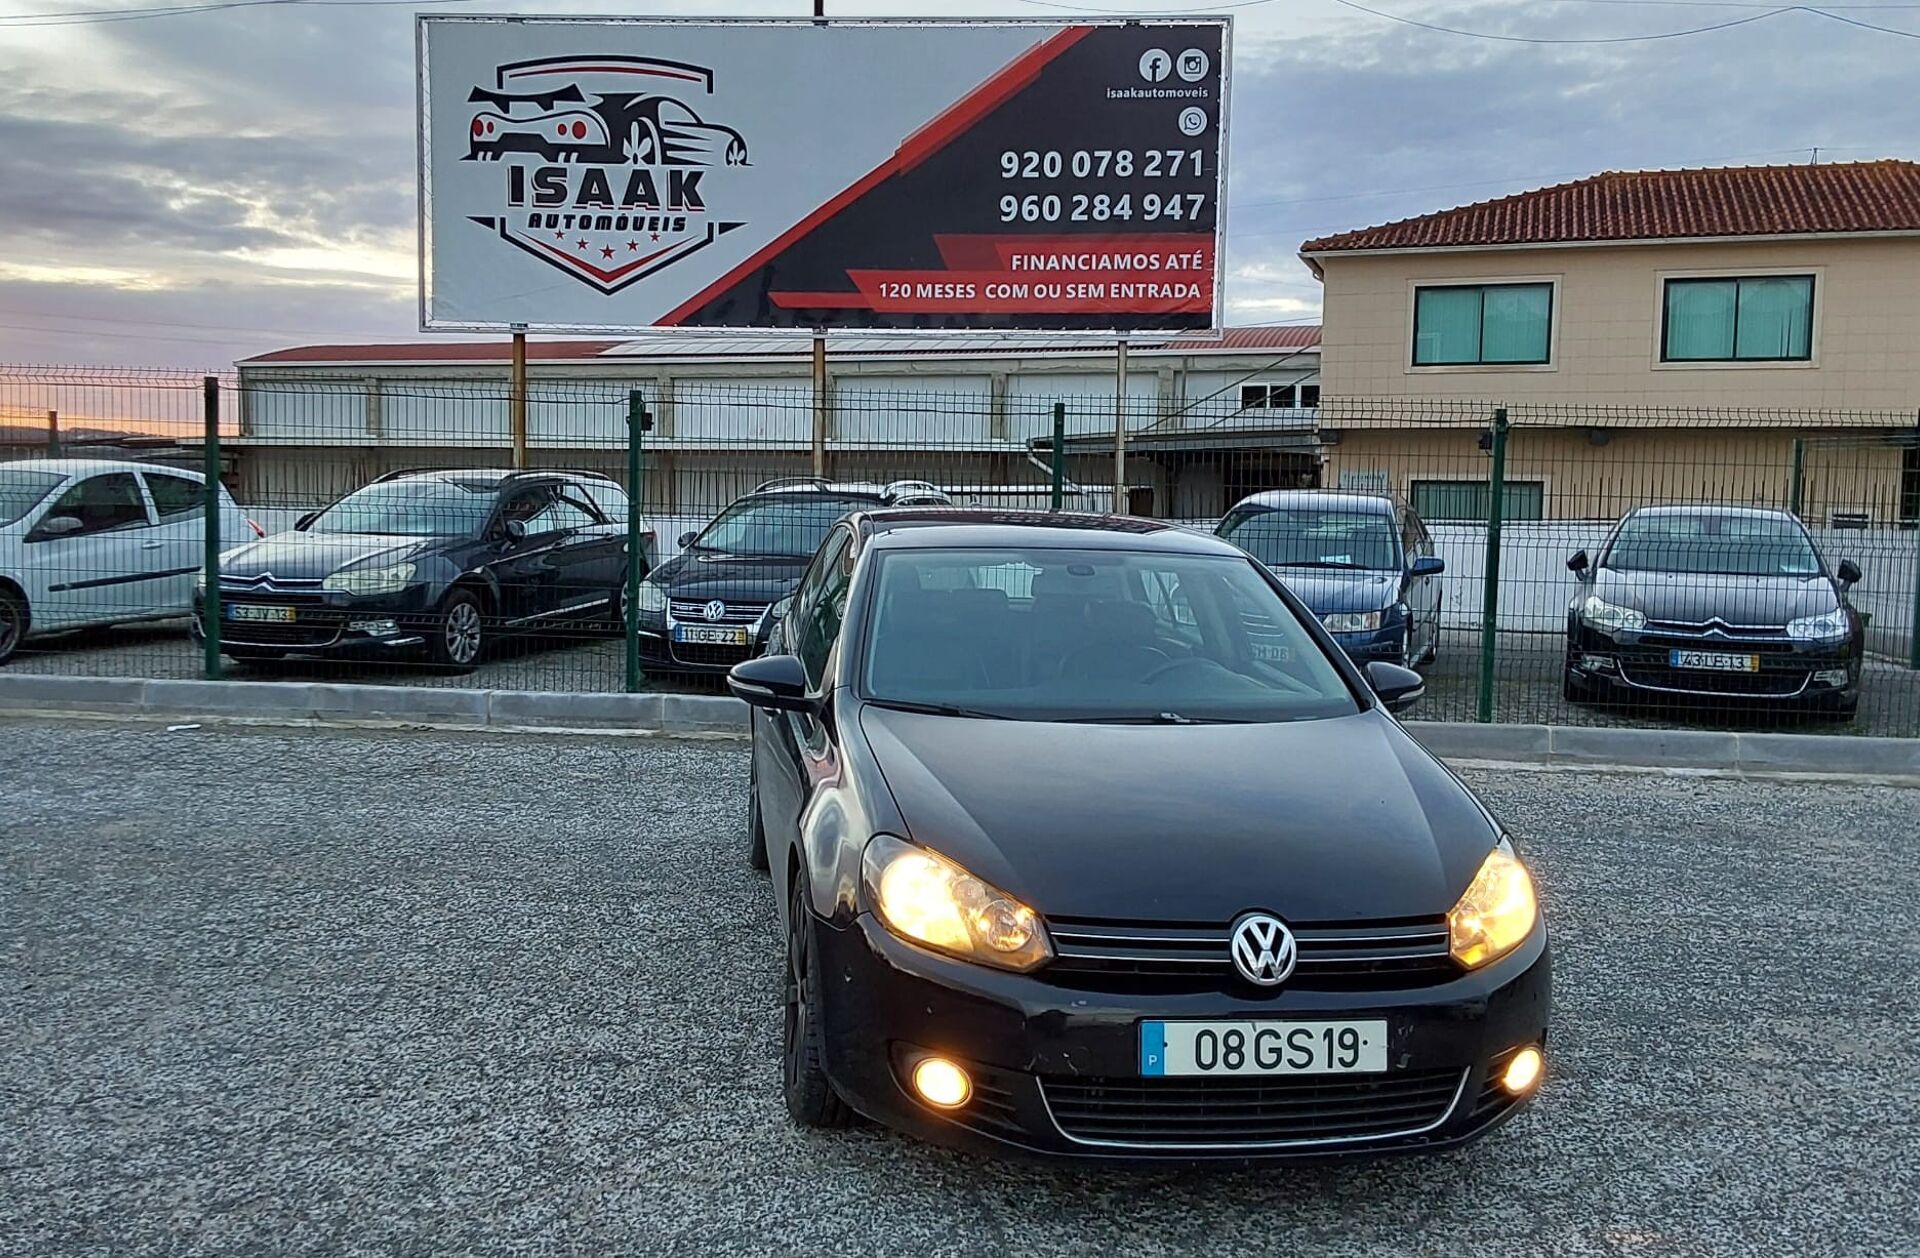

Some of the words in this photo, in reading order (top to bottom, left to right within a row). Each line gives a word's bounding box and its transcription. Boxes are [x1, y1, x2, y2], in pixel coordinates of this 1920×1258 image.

[1106, 87, 1208, 98] isaakautomoveis
[1001, 151, 1062, 178] 920
[1072, 150, 1134, 177] 078
[1143, 150, 1203, 177] 271
[508, 165, 706, 212] ISAAK
[1000, 195, 1061, 222] 960
[1071, 194, 1132, 221] 284
[1142, 193, 1205, 221] 947
[1011, 253, 1161, 271] FINANCIAMOS
[1165, 249, 1203, 270] ATÉ
[879, 283, 911, 298] 120
[916, 283, 976, 299] MESES
[985, 284, 1028, 299] COM
[1033, 283, 1061, 299] OU
[1066, 283, 1104, 298] SEM
[1110, 283, 1201, 299] ENTRADA
[1148, 1054, 1158, 1066] P
